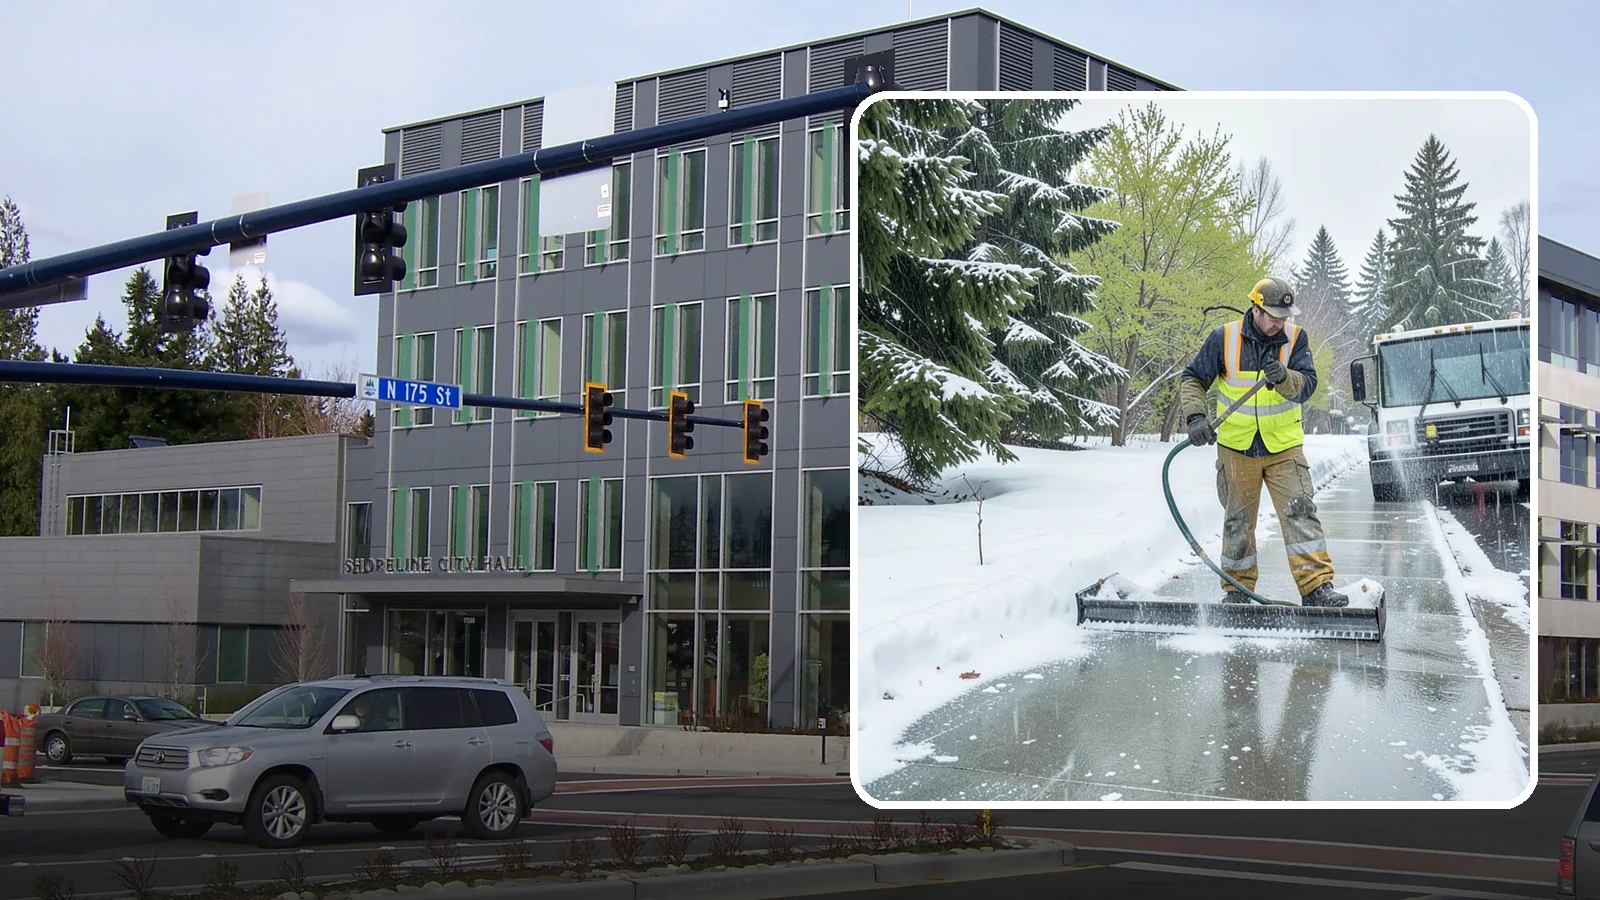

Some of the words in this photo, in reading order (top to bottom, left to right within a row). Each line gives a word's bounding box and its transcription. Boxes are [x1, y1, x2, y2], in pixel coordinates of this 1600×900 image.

[387, 380, 396, 400] N
[405, 382, 427, 403] 175
[436, 386, 451, 406] St
[343, 557, 432, 574] SHORELINE
[438, 556, 475, 572] CITY
[484, 555, 526, 571] HALL
